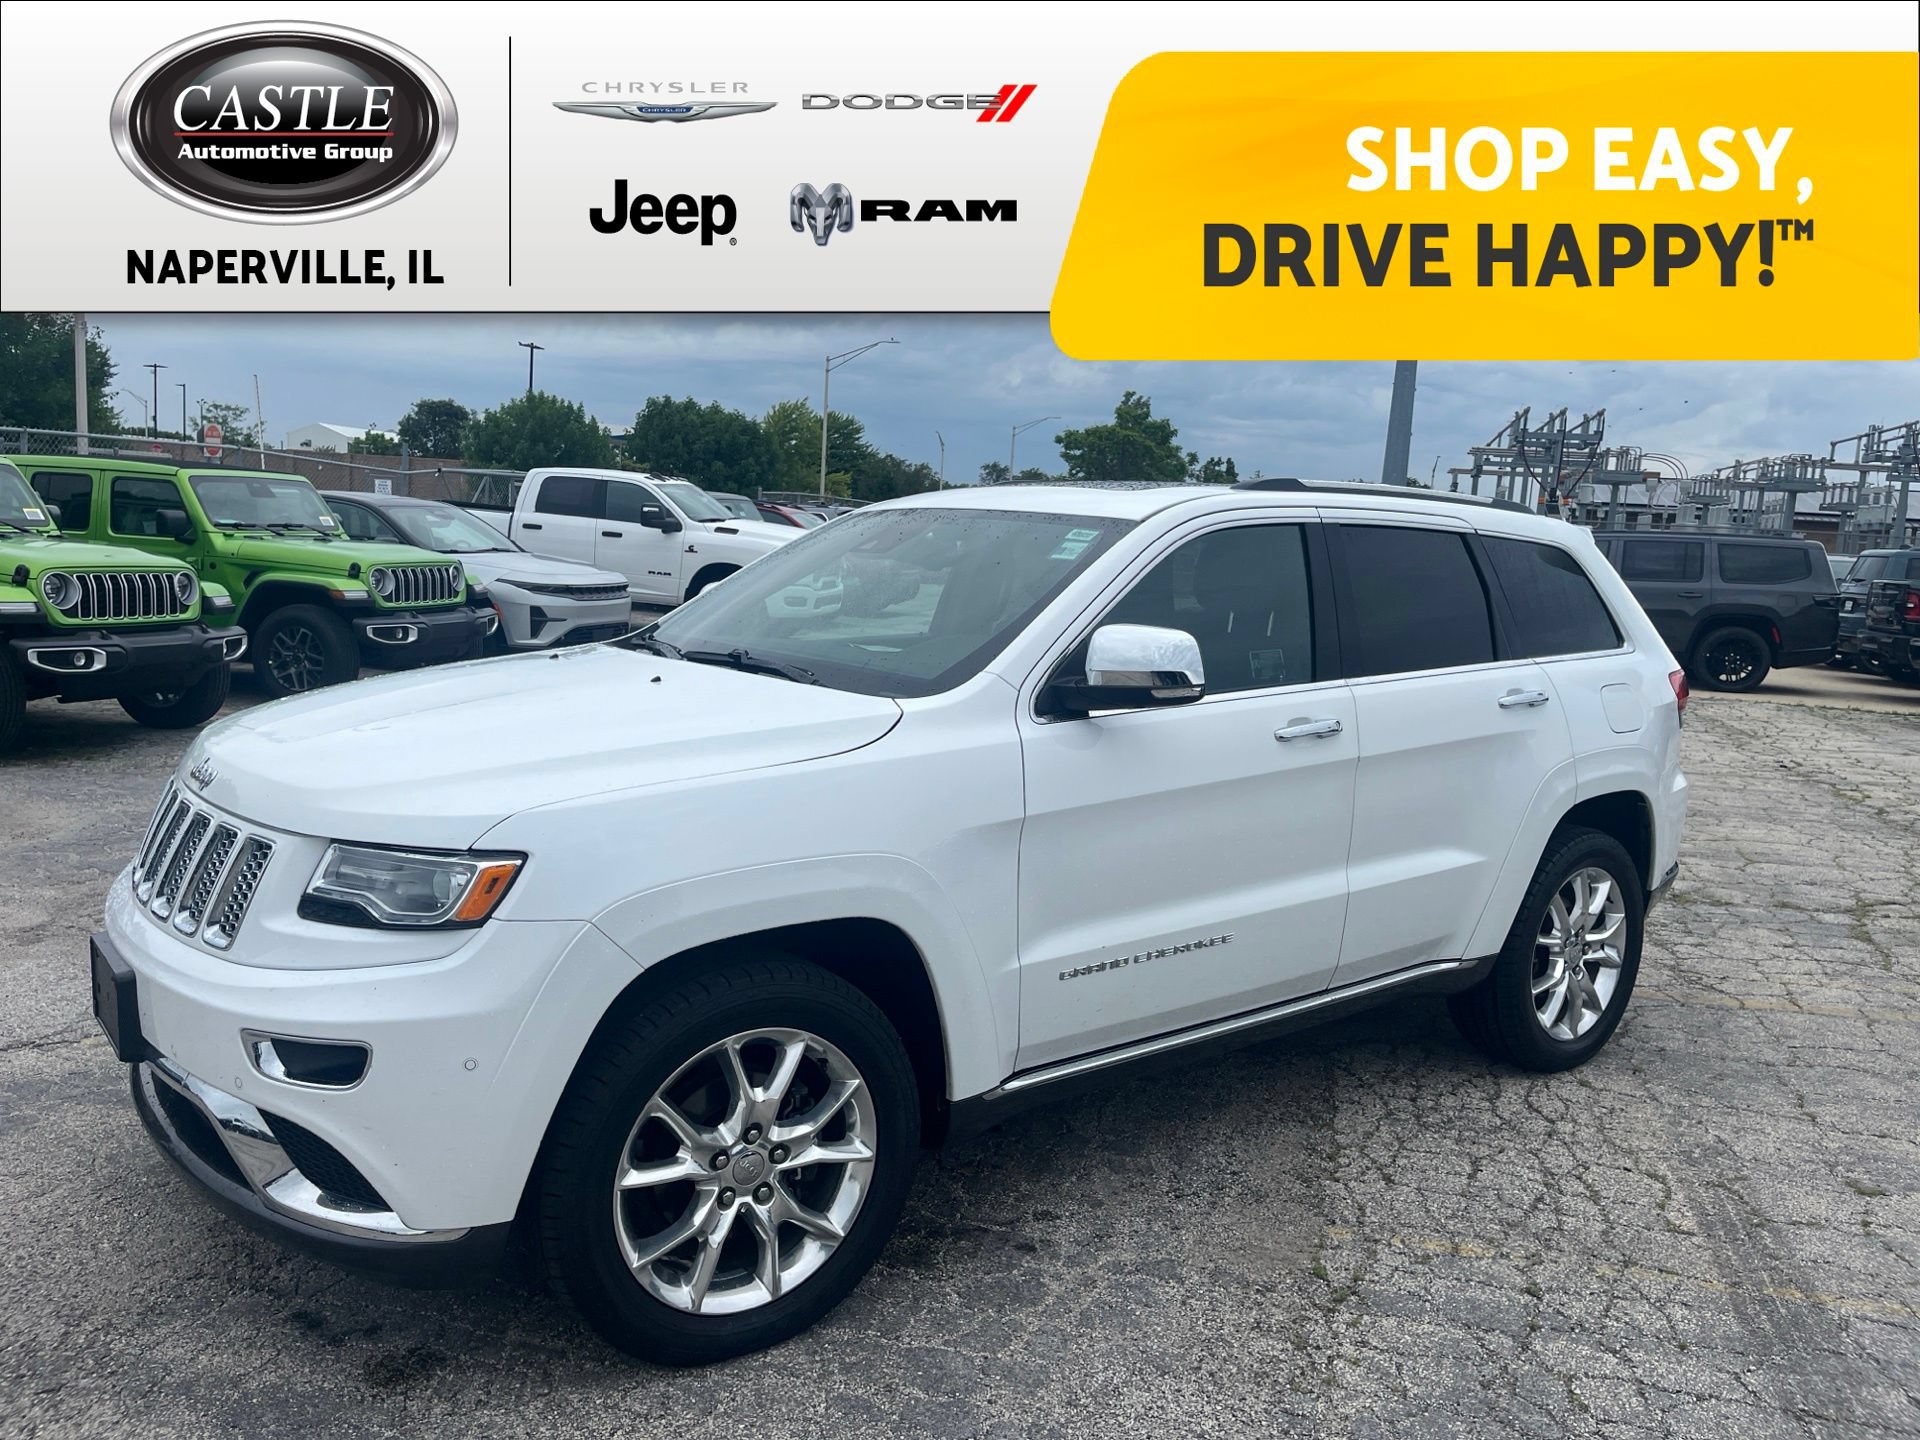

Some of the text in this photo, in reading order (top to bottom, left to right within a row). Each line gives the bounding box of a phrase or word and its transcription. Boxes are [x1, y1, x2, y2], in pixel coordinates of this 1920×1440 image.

[190, 757, 219, 791] Jeep
[1059, 932, 1235, 981] GRAND CHEROKEE
